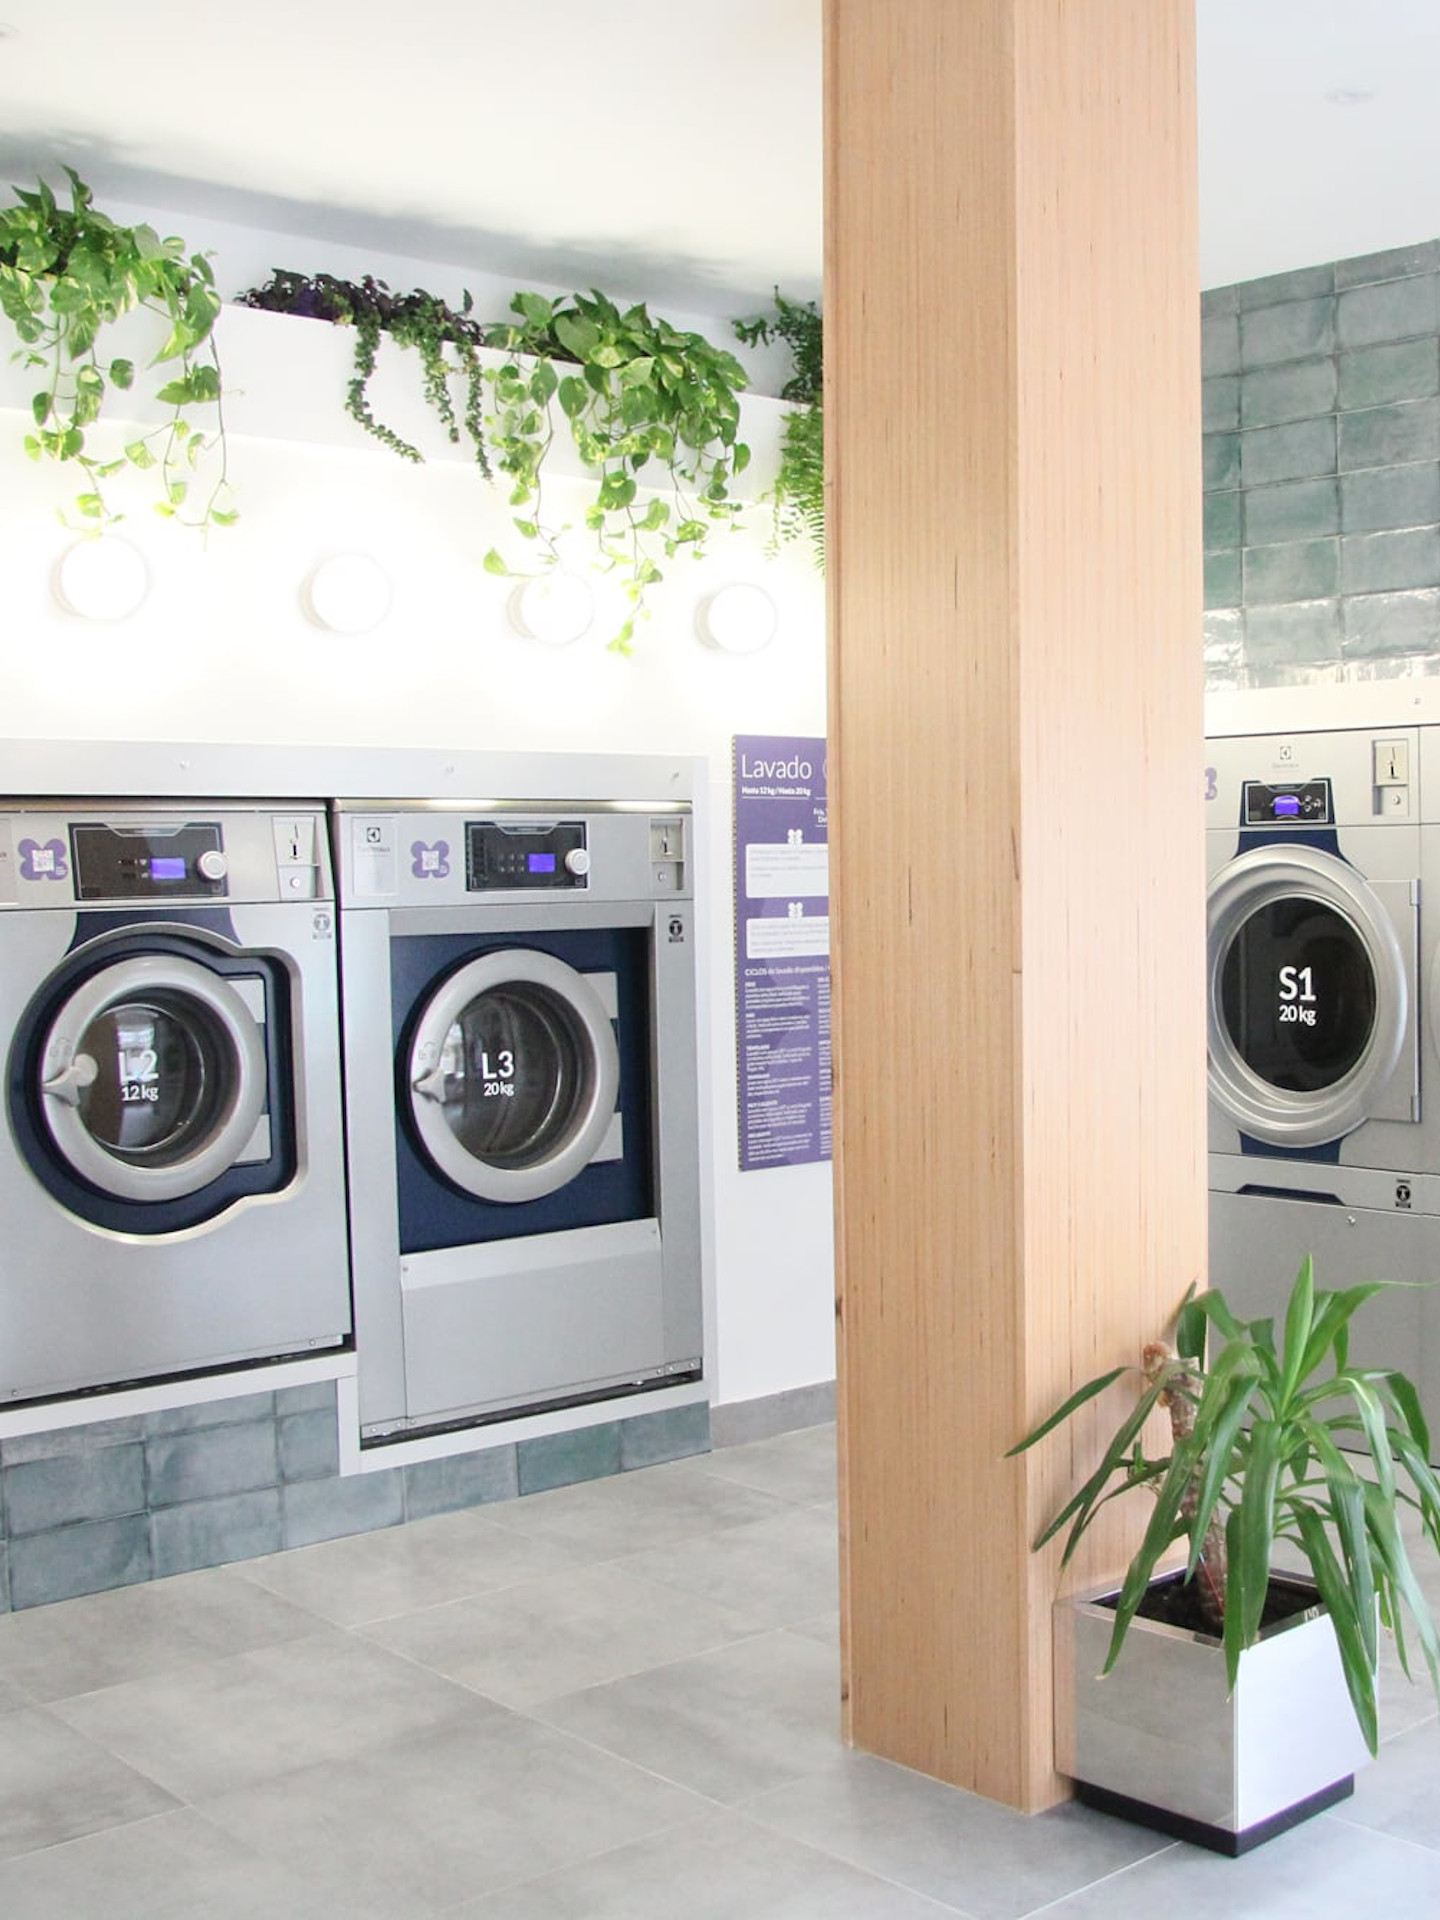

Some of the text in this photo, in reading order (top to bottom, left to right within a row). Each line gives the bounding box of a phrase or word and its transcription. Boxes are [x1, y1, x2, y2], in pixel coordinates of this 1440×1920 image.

[741, 754, 812, 780] Lavado
[1279, 965, 1317, 1001] S1
[118, 1049, 159, 1081] L2
[482, 1050, 515, 1079] L3
